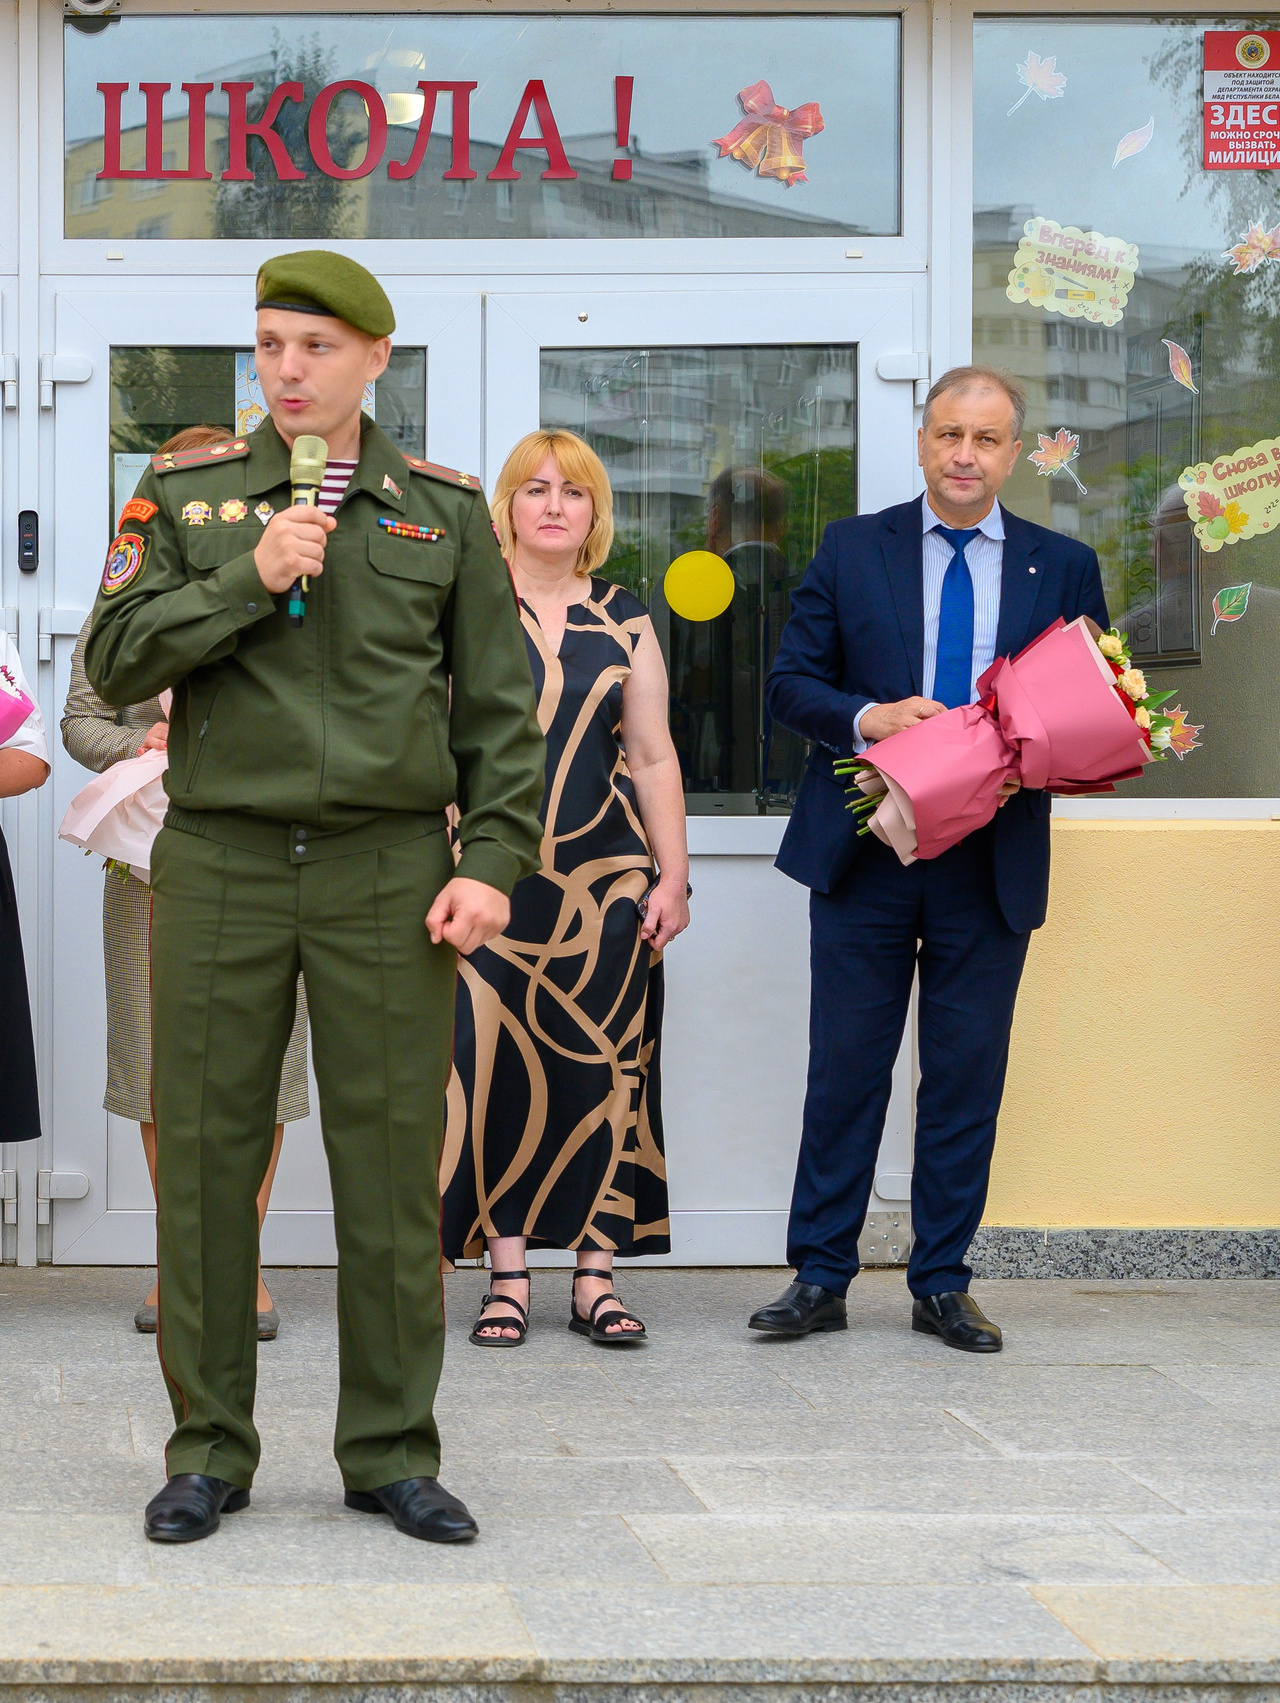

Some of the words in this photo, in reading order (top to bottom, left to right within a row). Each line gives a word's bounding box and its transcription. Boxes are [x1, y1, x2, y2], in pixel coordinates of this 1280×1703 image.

[1245, 78, 1275, 86] ЗАЩИТОЙ
[1210, 131, 1251, 139] МОЖНО
[1228, 140, 1277, 149] ВЫЗВАТЬ
[1038, 224, 1111, 263] Вперёд
[1114, 250, 1127, 264] к
[1034, 250, 1120, 284] знаниям!
[1212, 452, 1269, 481] Снова
